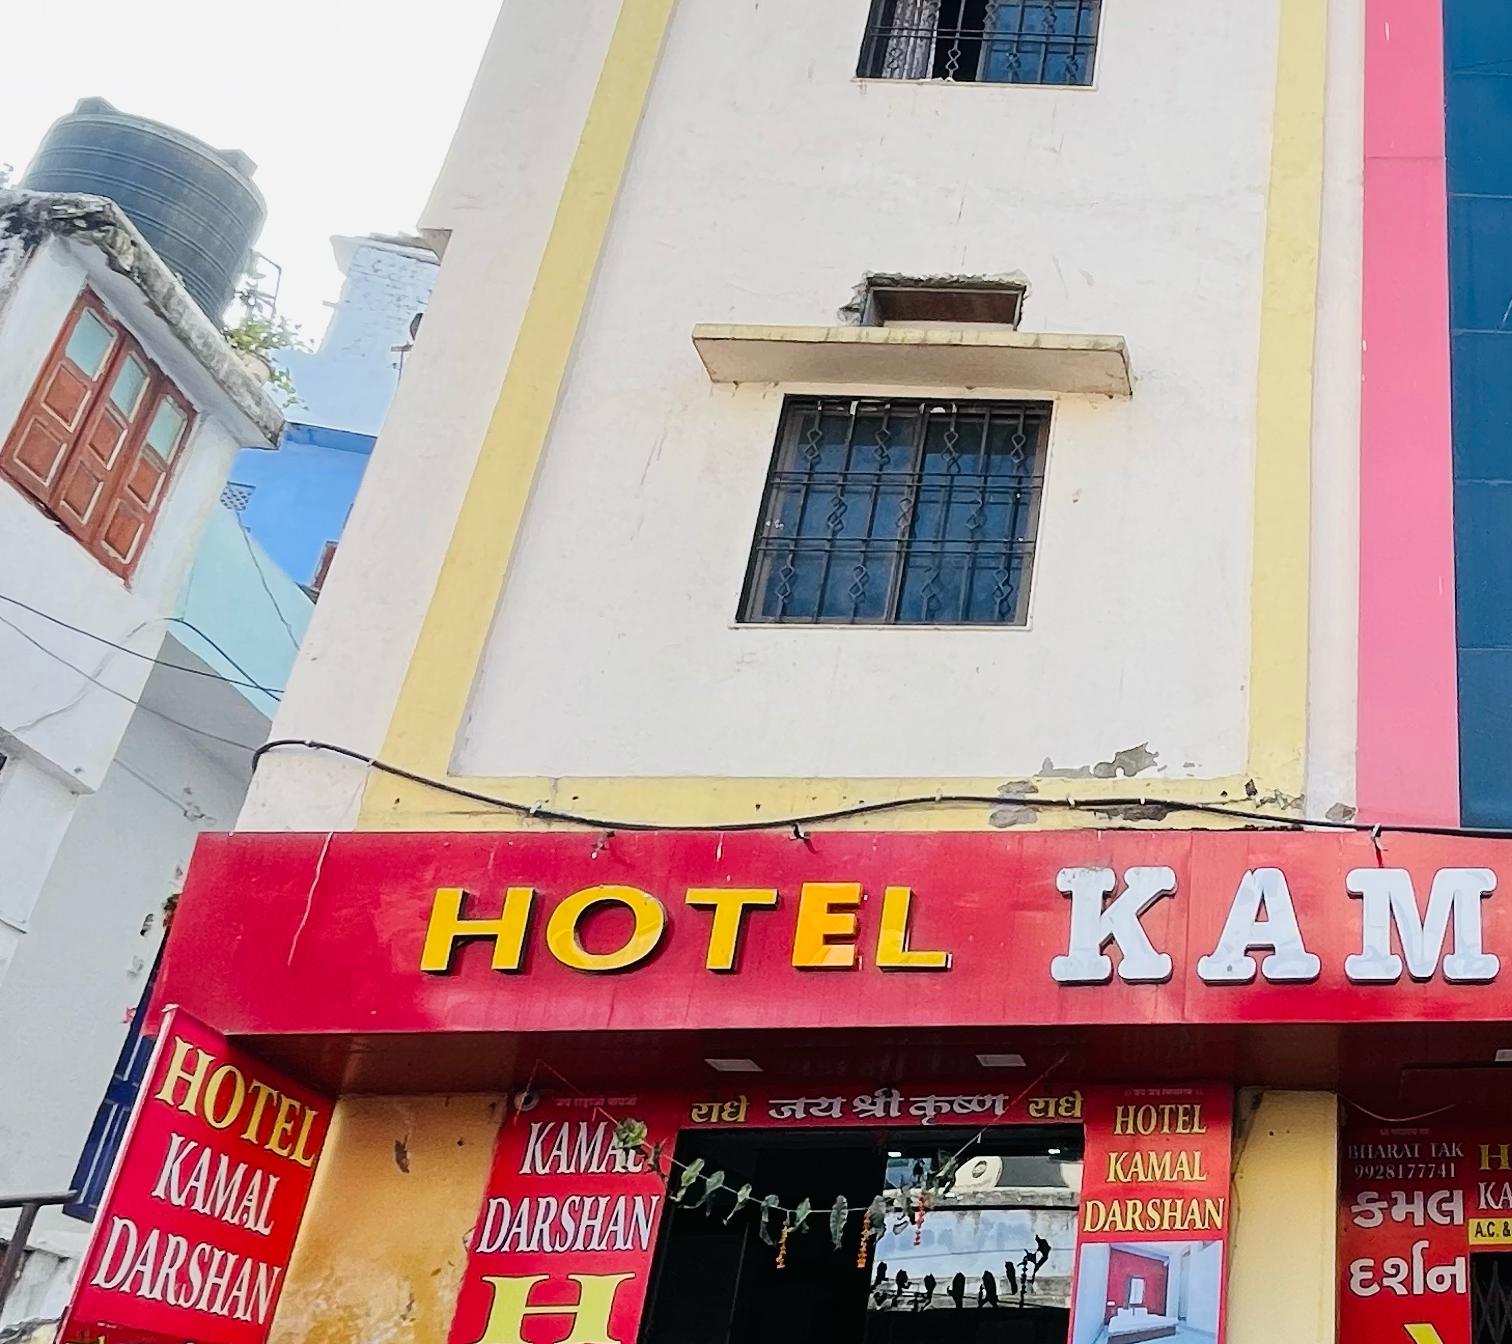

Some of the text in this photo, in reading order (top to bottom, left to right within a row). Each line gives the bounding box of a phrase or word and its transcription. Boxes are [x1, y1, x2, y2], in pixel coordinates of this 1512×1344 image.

[420, 881, 953, 972] HOTEL
[155, 1036, 319, 1168] HOTEL
[691, 1088, 1083, 1126] राधे जय श्री कृष्ण राधे
[1113, 1104, 1208, 1136] HOTEL
[1106, 1150, 1208, 1183] KAMAL
[1349, 1142, 1465, 1160] BHARAT TAK
[1354, 1162, 1456, 1179] 9928177741
[151, 1132, 281, 1236] KAMAL
[476, 1195, 660, 1253] DARSHAN
[1083, 1197, 1225, 1233] DARSHAN
[1350, 1189, 1464, 1229] કમલ
[1474, 1220, 1500, 1238] A.C.
[1502, 1221, 1511, 1237] &
[90, 1215, 282, 1325] DARSHAN
[1349, 1239, 1467, 1297] દર્શન
